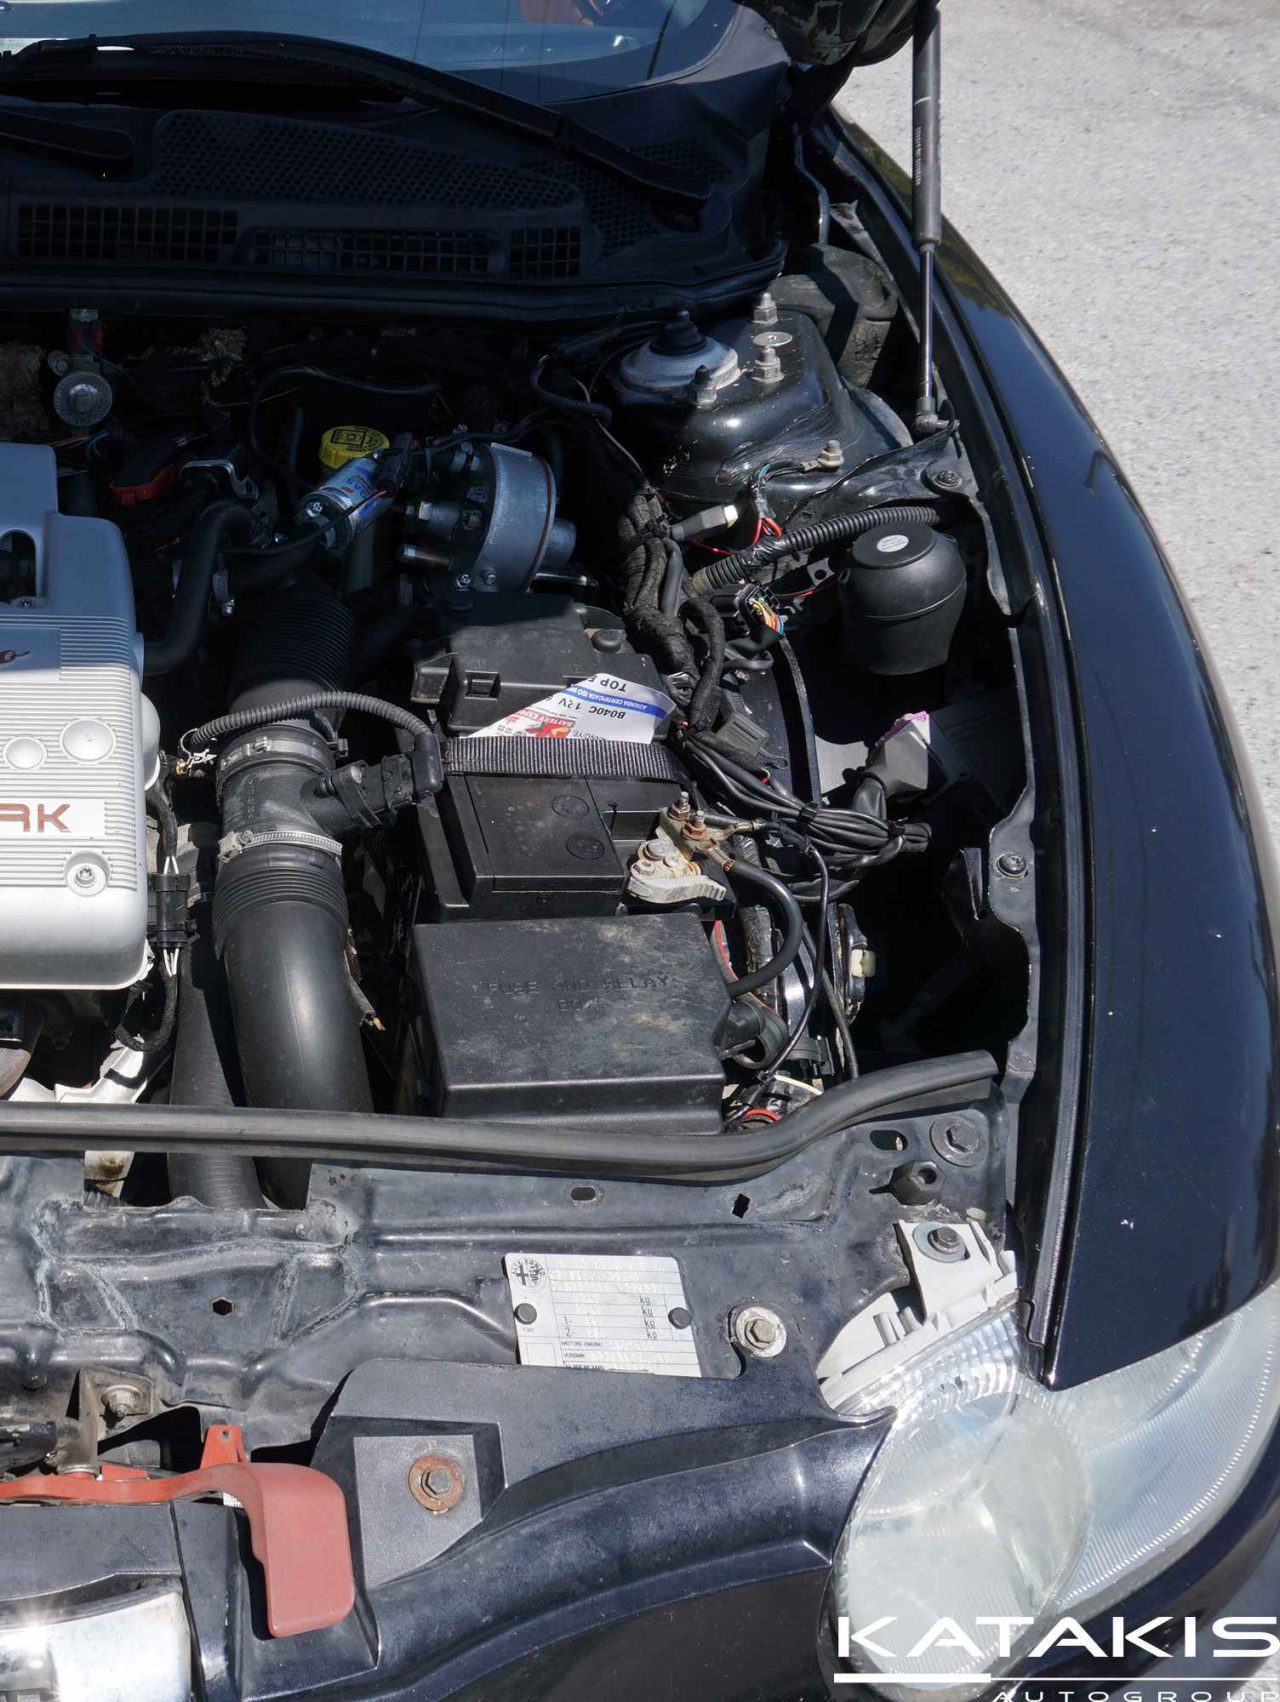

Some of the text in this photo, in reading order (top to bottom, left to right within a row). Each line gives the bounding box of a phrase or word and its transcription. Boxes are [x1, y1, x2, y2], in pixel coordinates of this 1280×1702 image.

[600, 678, 628, 692] TOP
[603, 975, 670, 993] RELAY
[640, 1294, 651, 1306] kg
[642, 1306, 654, 1318] kg
[645, 1318, 656, 1330] kg
[647, 1330, 658, 1341] kg
